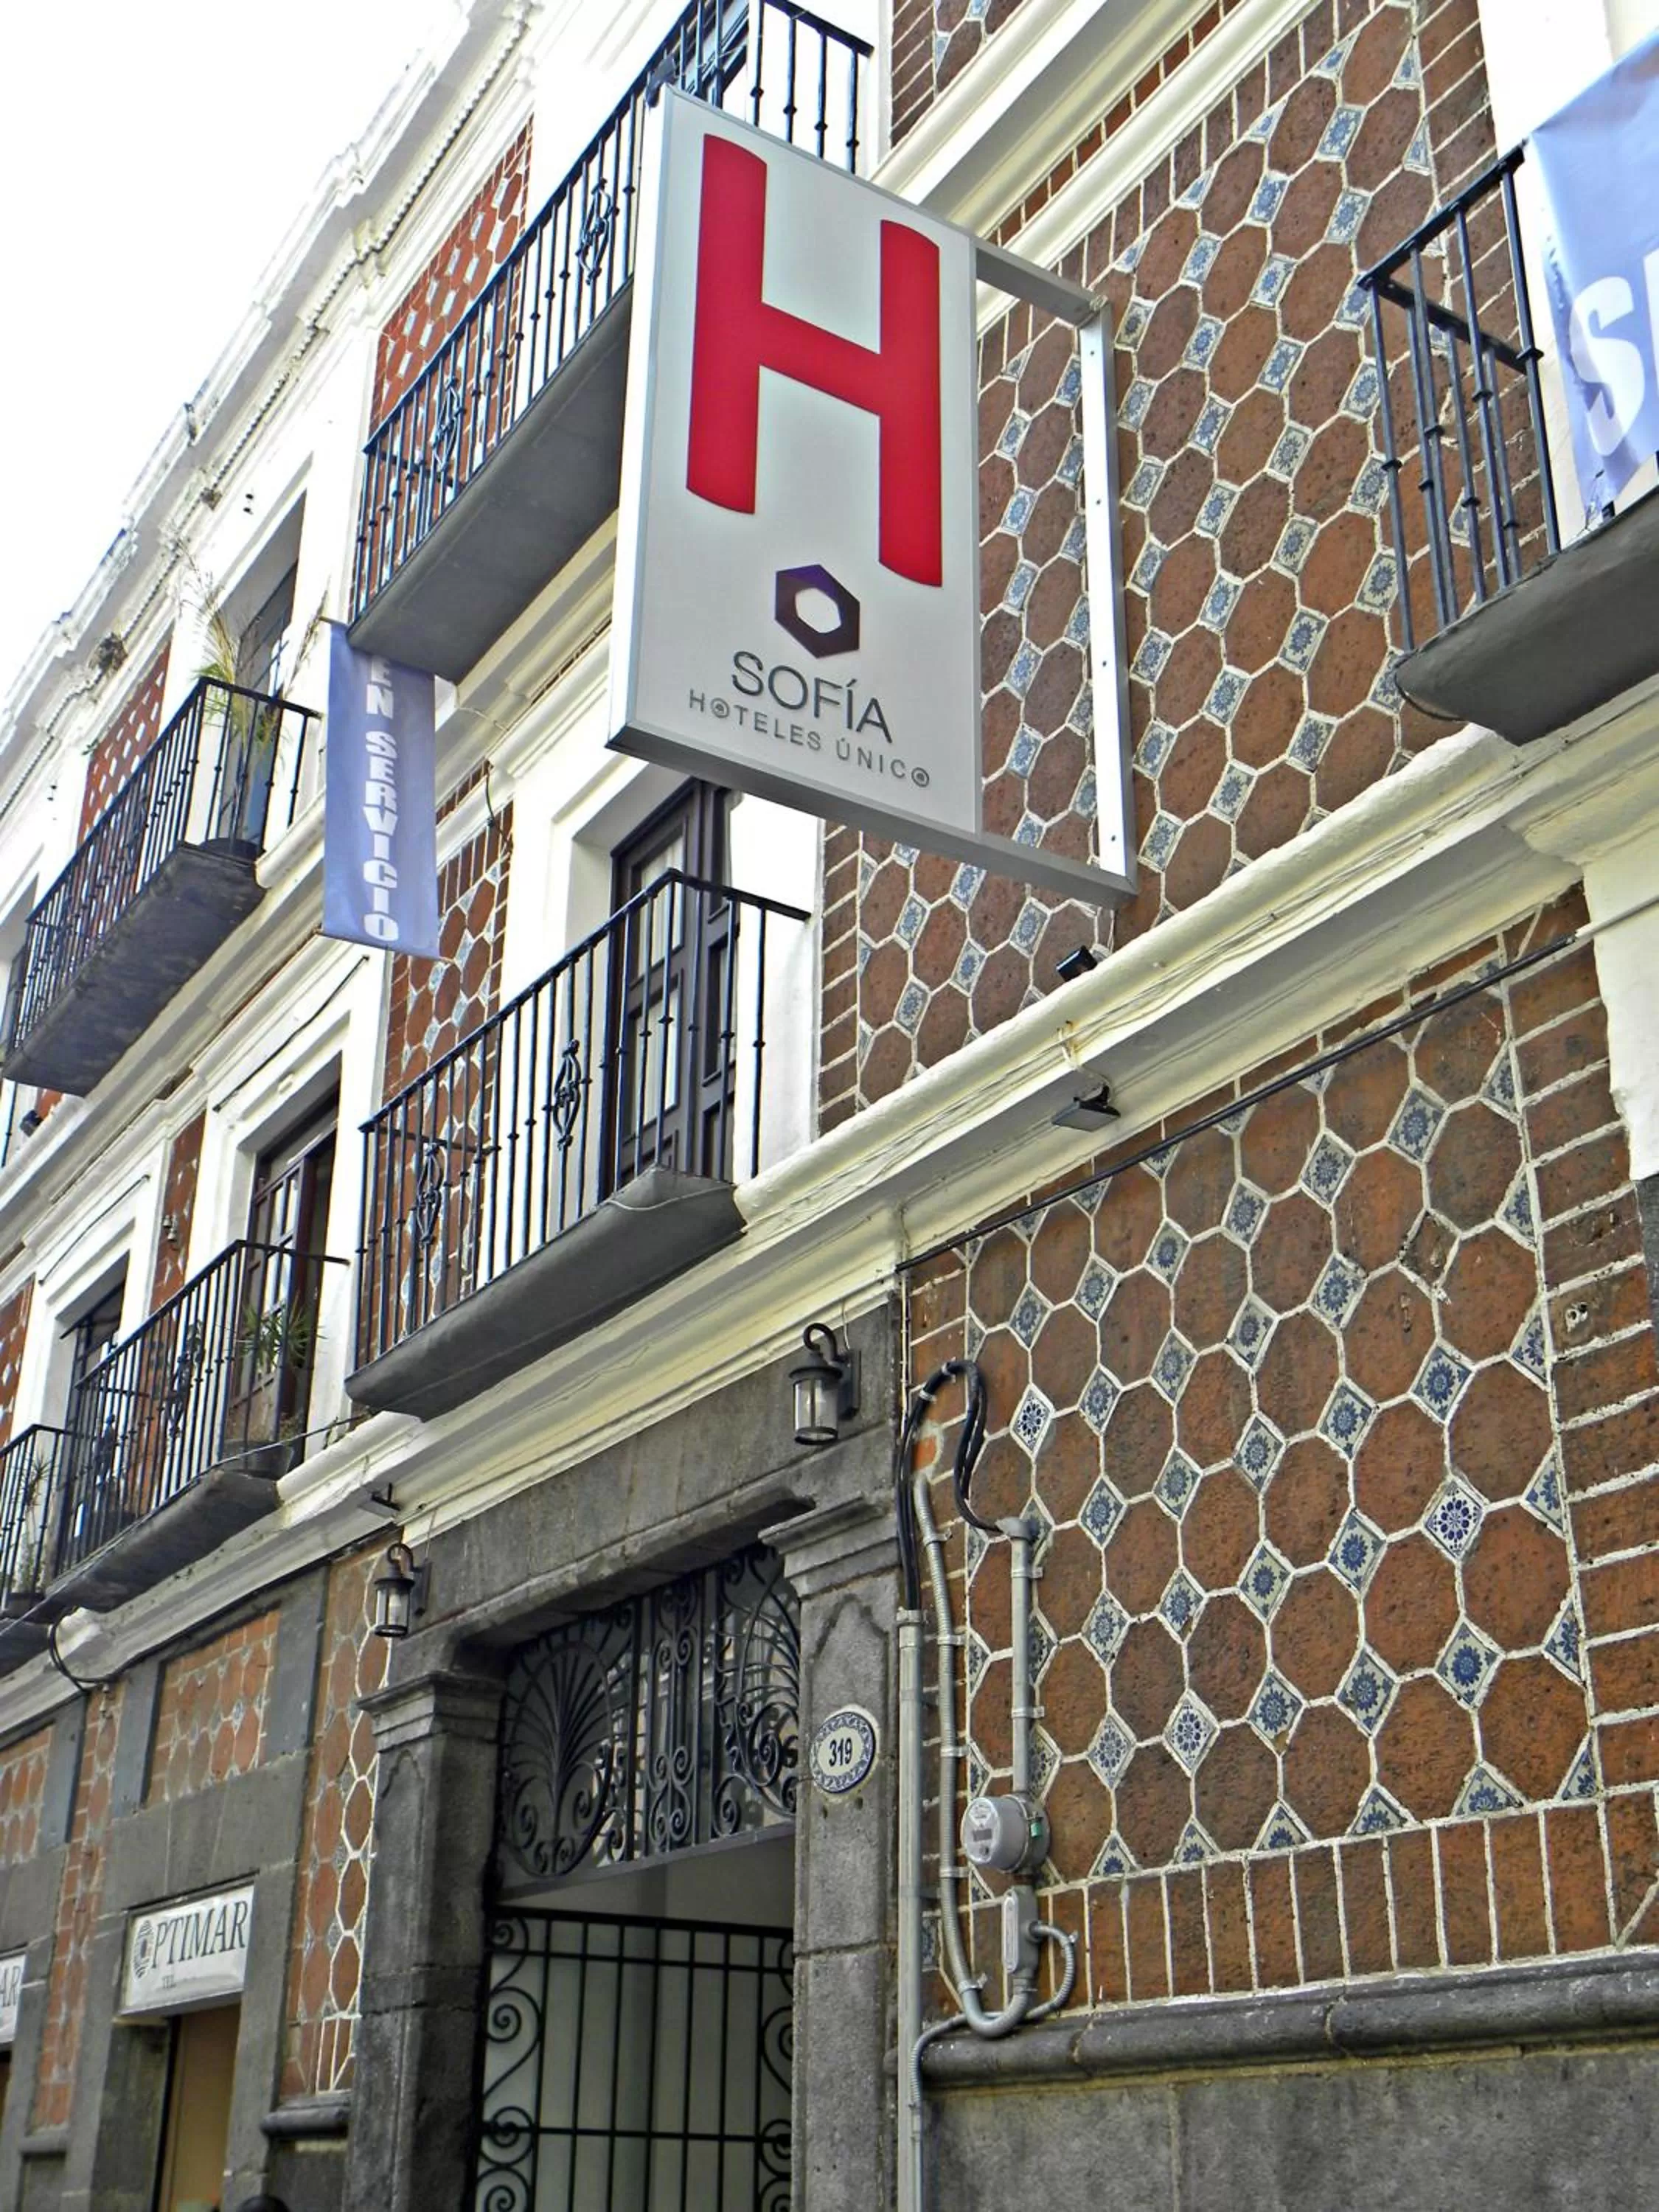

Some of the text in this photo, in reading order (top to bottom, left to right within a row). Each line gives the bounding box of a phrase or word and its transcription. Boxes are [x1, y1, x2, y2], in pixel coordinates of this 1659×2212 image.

[686, 133, 942, 587] H
[1569, 248, 1659, 456] S
[689, 689, 931, 788] HOTELES ÚNICO
[731, 650, 893, 744] SOFÍA
[363, 731, 399, 941] SERVICIO
[828, 1736, 853, 1767] 319
